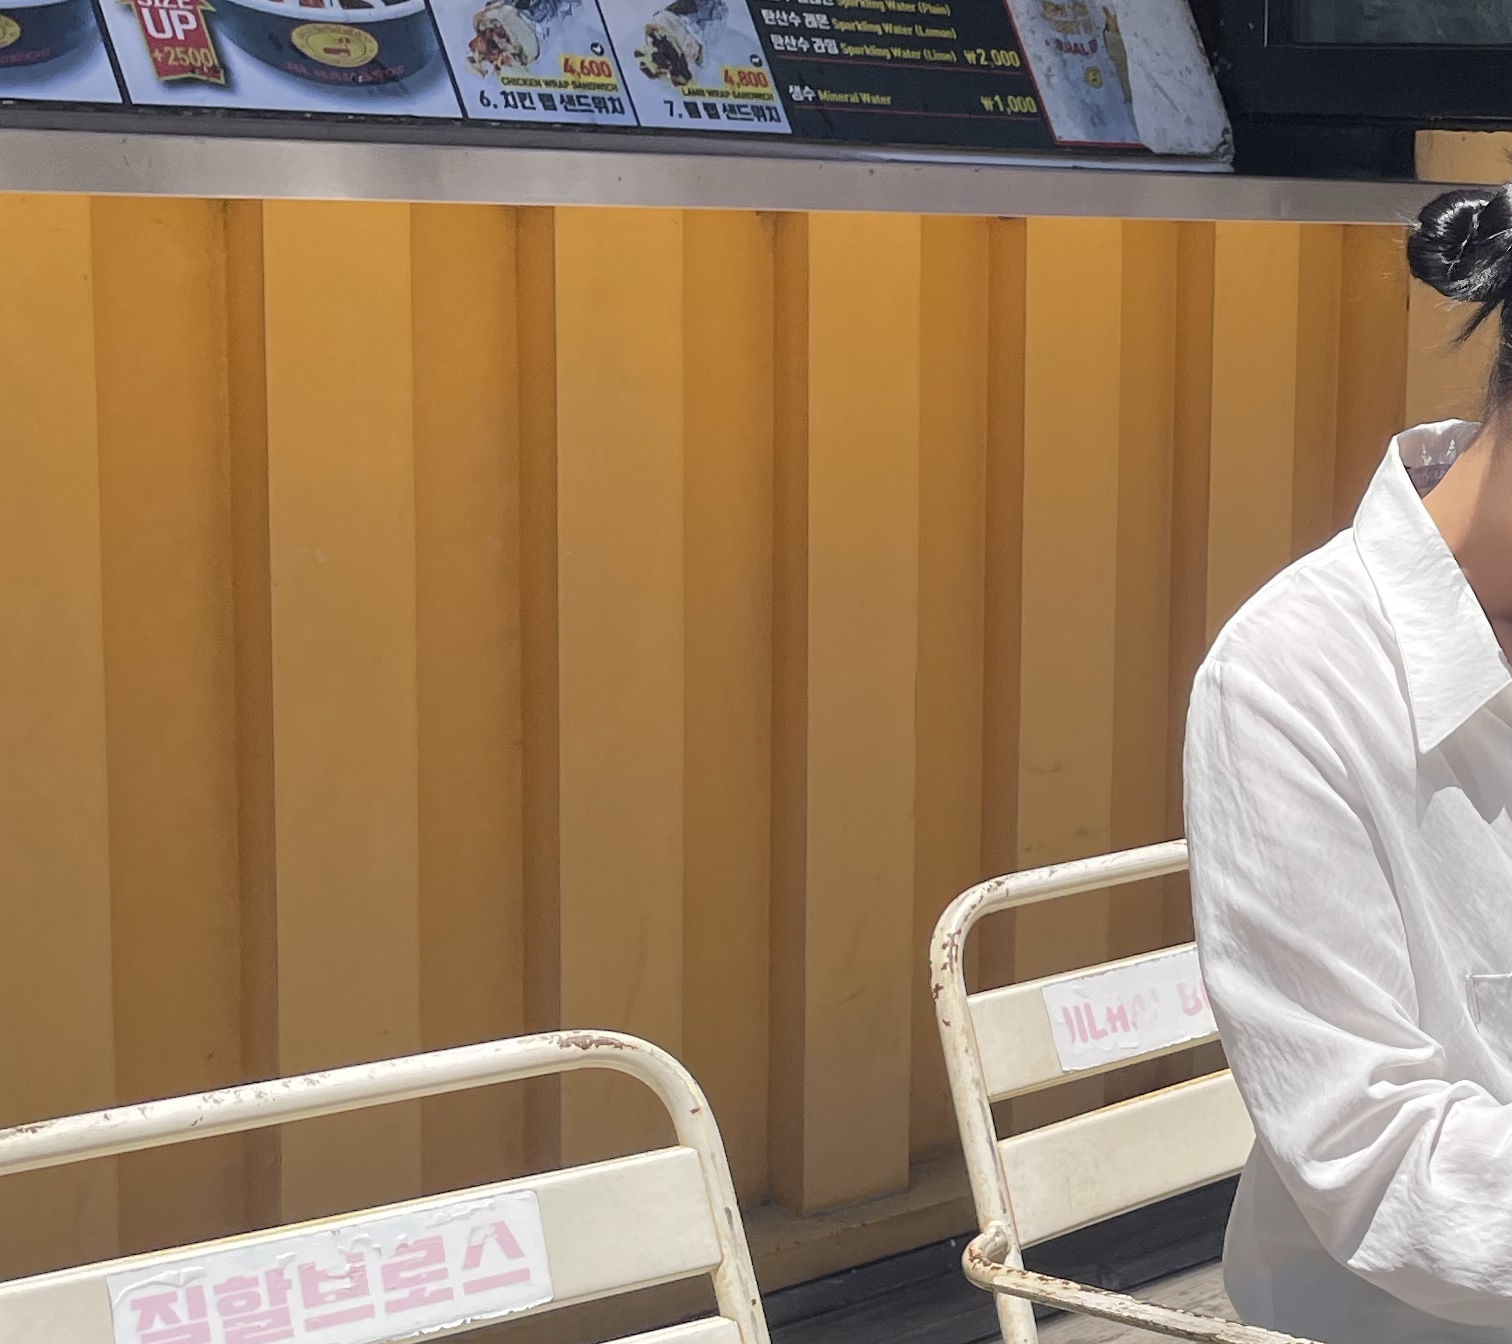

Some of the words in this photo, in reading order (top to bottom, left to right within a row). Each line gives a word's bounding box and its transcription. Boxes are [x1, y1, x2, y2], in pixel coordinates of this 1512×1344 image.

[141, 7, 197, 40] UP
[761, 9, 801, 28] 탄산수
[770, 34, 810, 52] 탄산수
[563, 57, 613, 79] 4,600
[963, 48, 1021, 68] ₩2,000
[723, 68, 769, 88] 4,800
[559, 94, 625, 115] 샌드위치
[817, 89, 859, 104] Mineral
[860, 92, 892, 106] Water
[980, 94, 1038, 114] ₩1,000
[721, 103, 782, 123] 샌드위치
